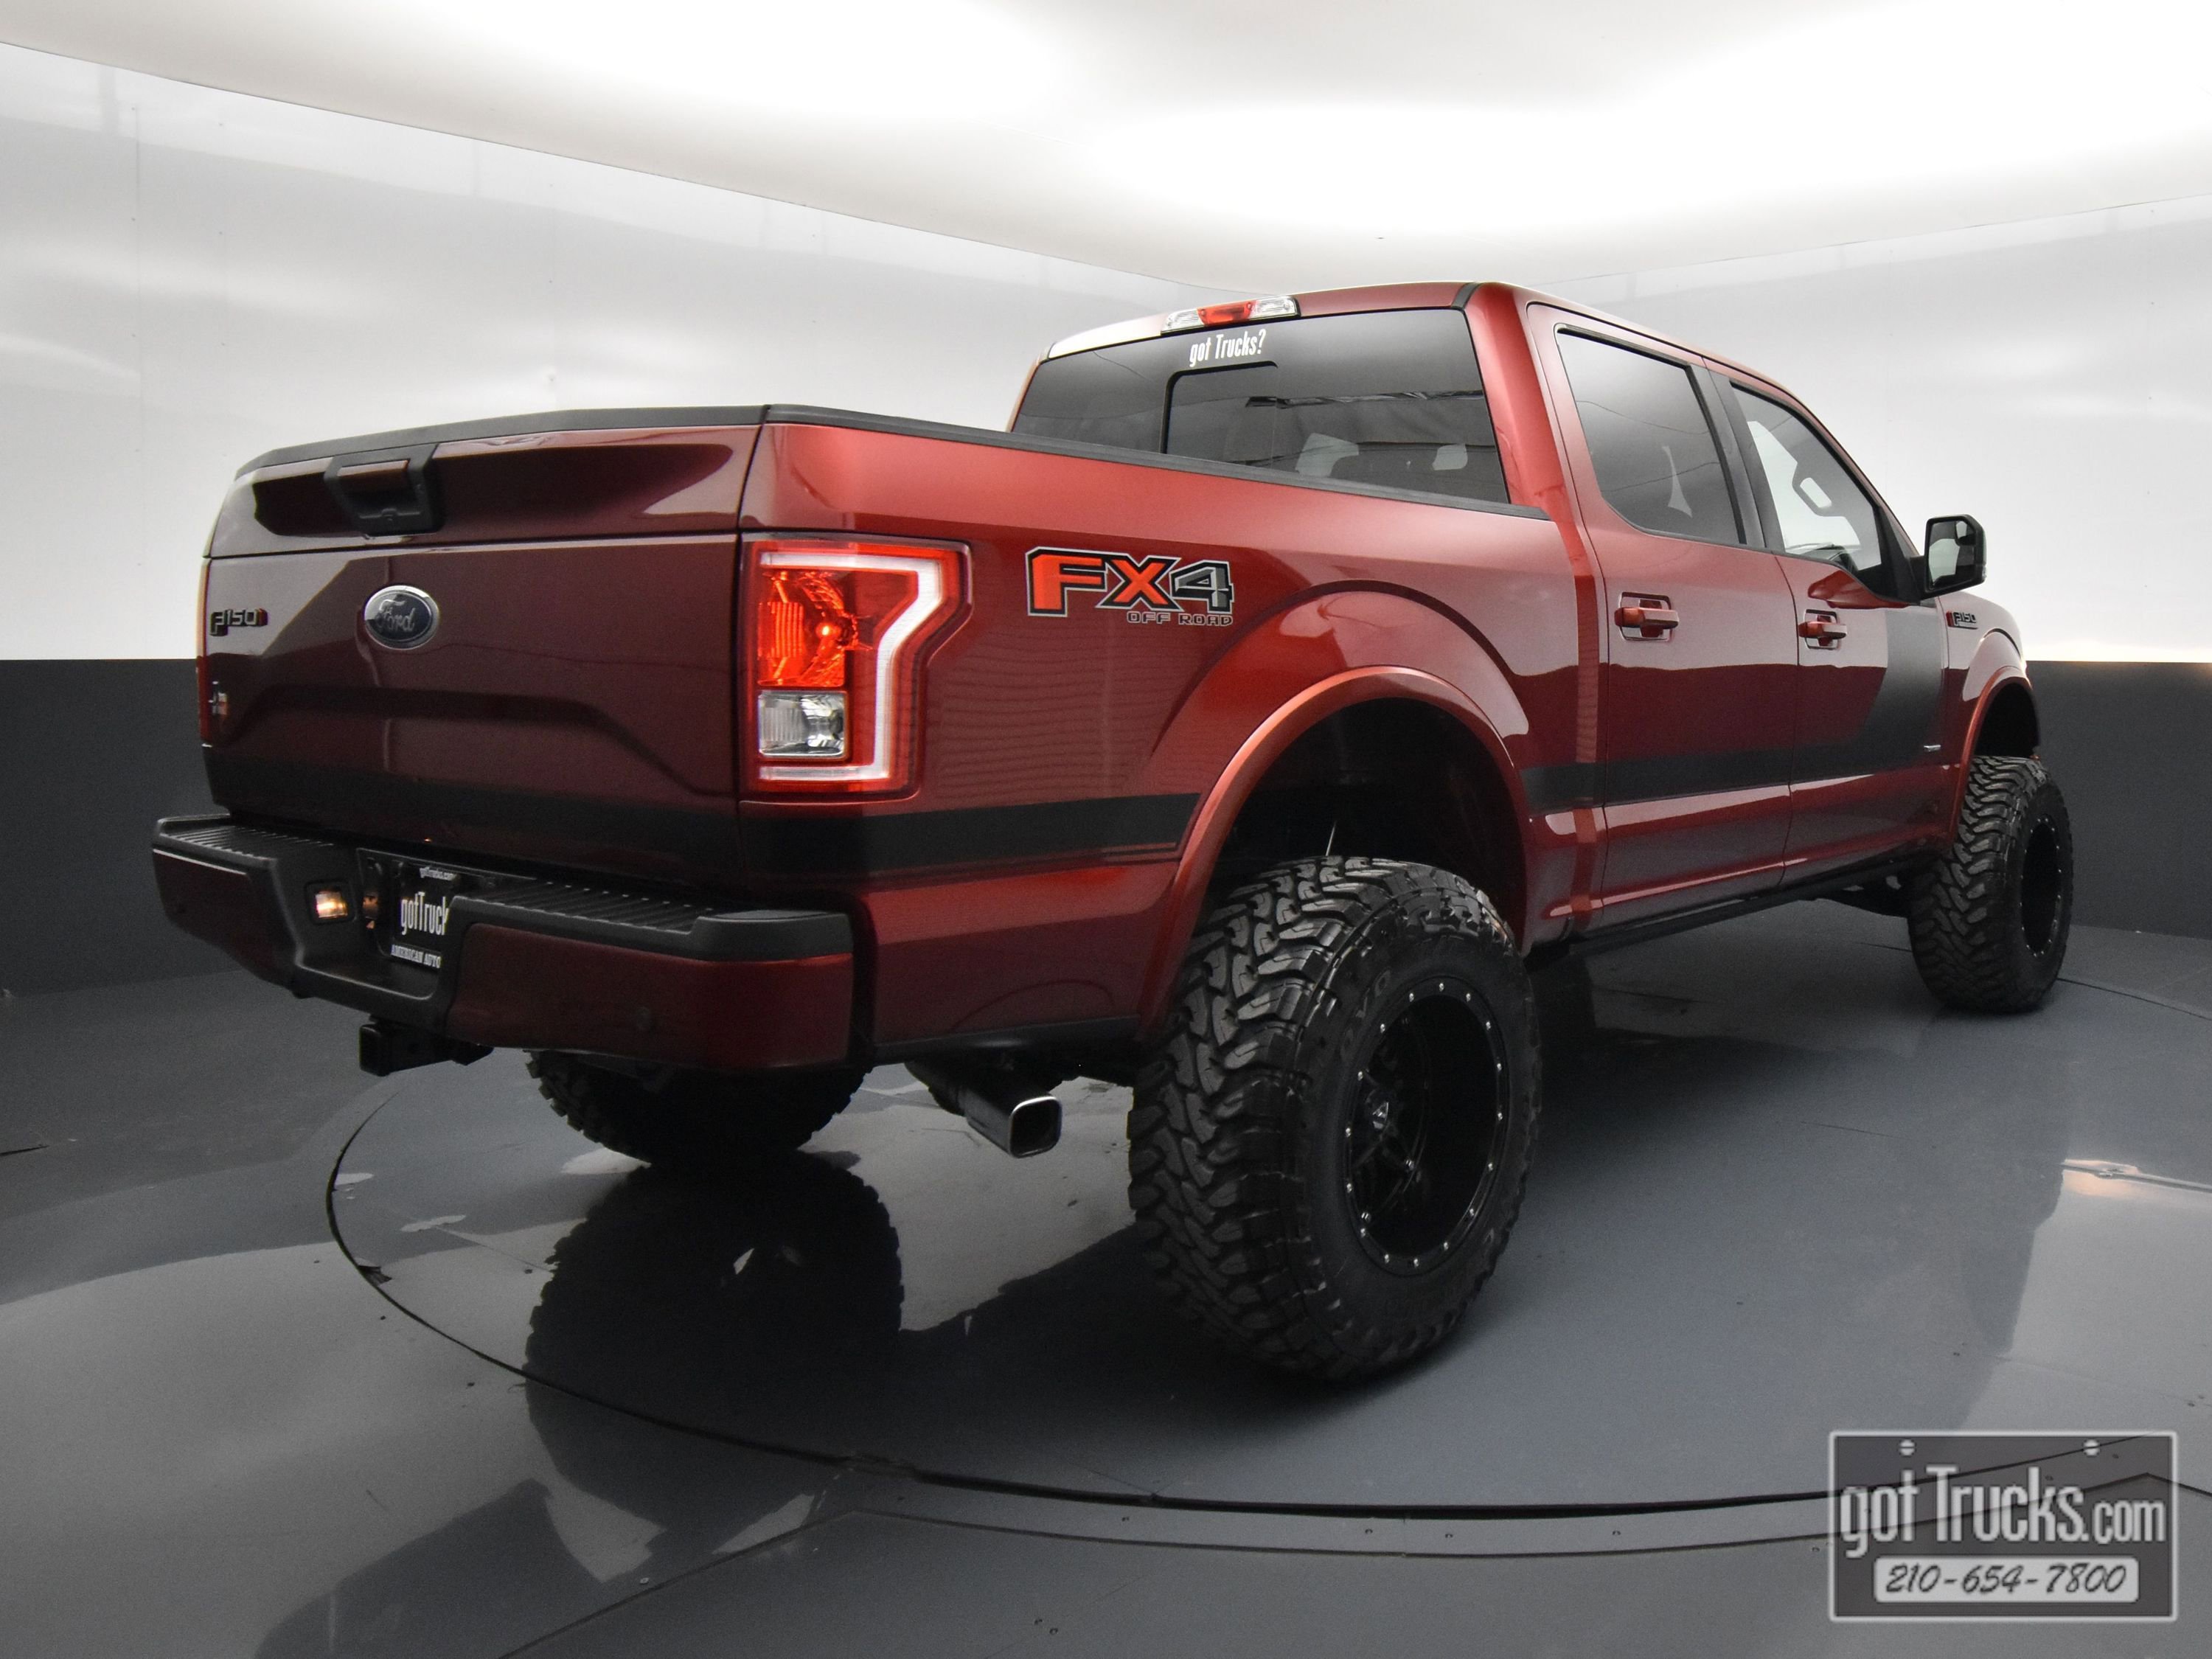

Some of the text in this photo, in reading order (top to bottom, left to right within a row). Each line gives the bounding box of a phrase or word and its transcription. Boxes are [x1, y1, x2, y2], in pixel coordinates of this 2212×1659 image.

[1189, 329, 1267, 367] got Trucks?
[1025, 546, 1234, 618] FX4
[375, 598, 417, 633] Ford
[1127, 611, 1233, 626] OFF ROAD
